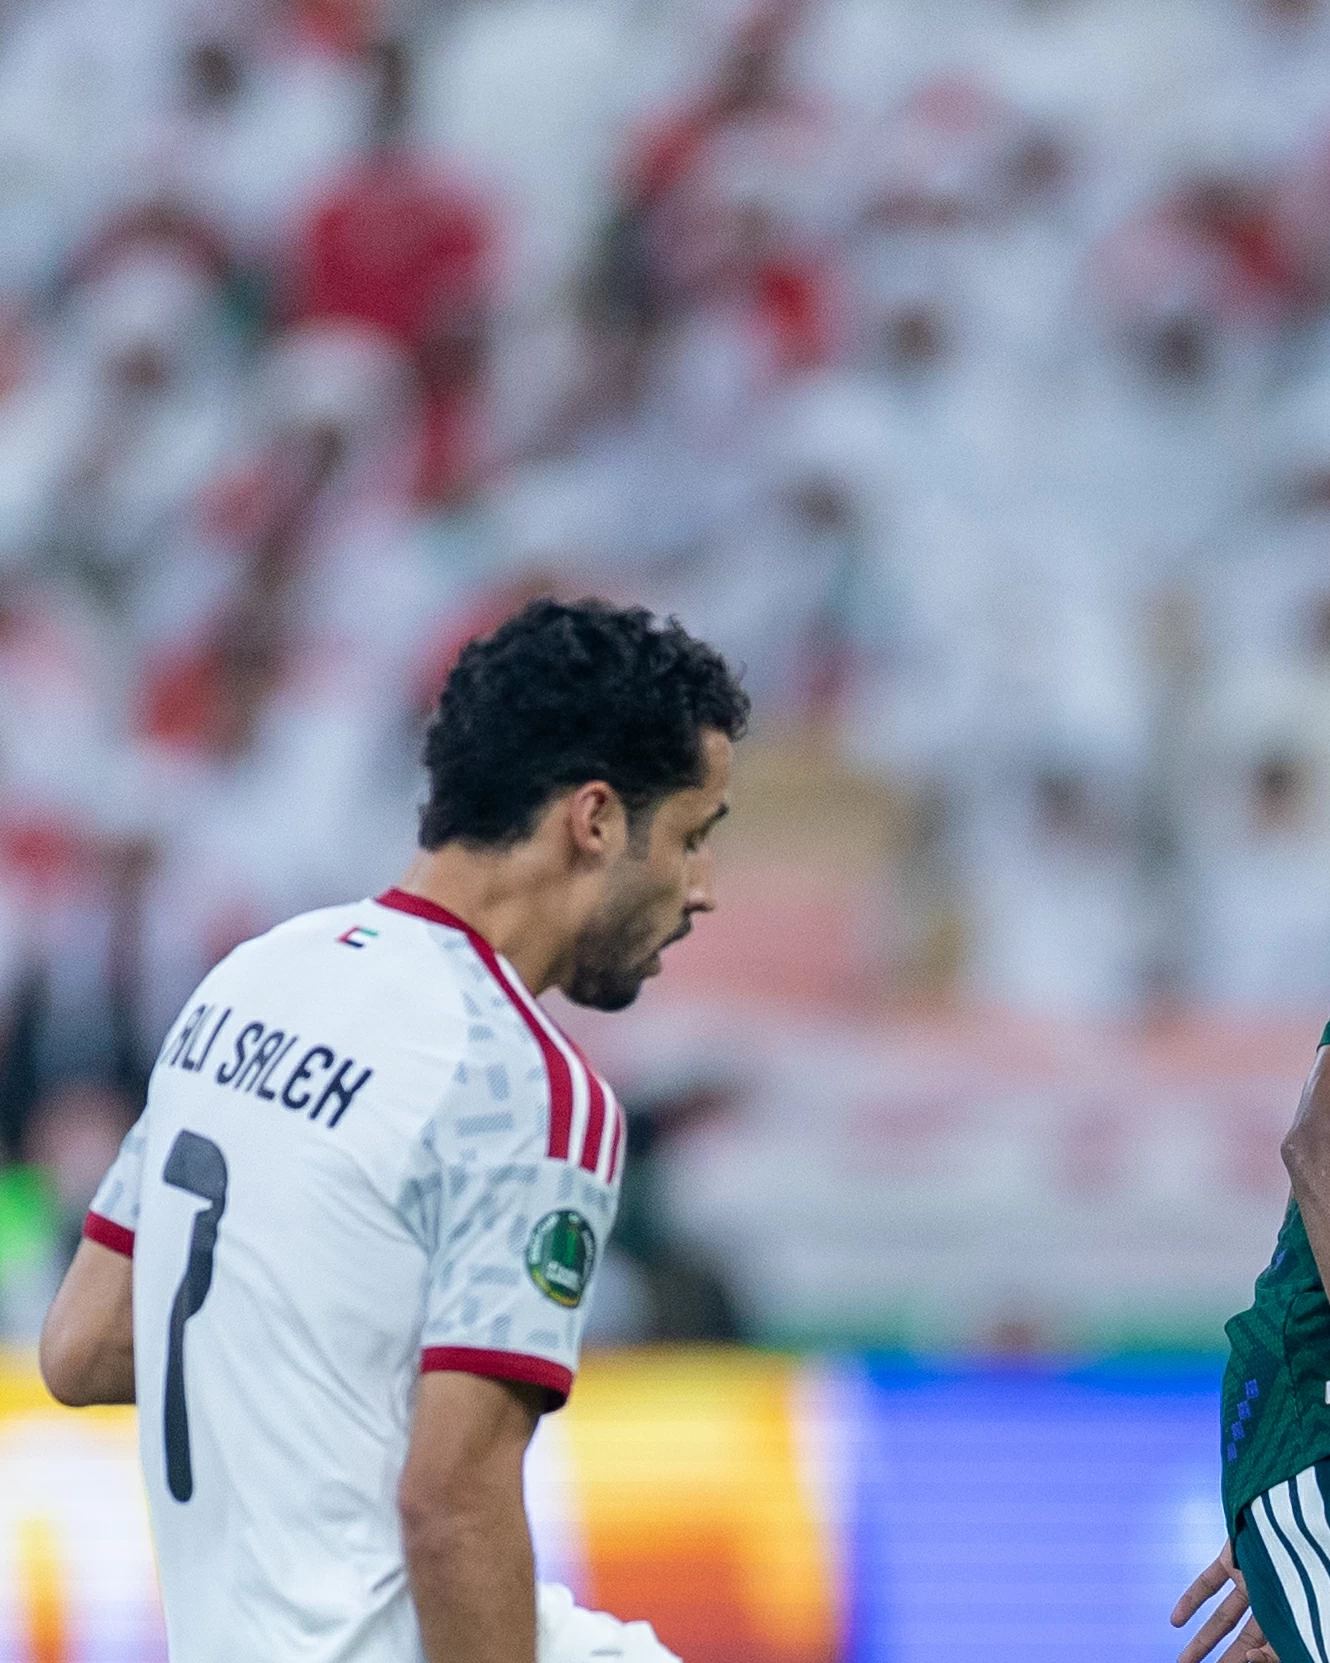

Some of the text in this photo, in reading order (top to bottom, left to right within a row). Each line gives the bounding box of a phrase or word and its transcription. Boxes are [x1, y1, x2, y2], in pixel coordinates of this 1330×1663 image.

[159, 1003, 373, 1129] ALI SALEH
[163, 1129, 228, 1503] 7
